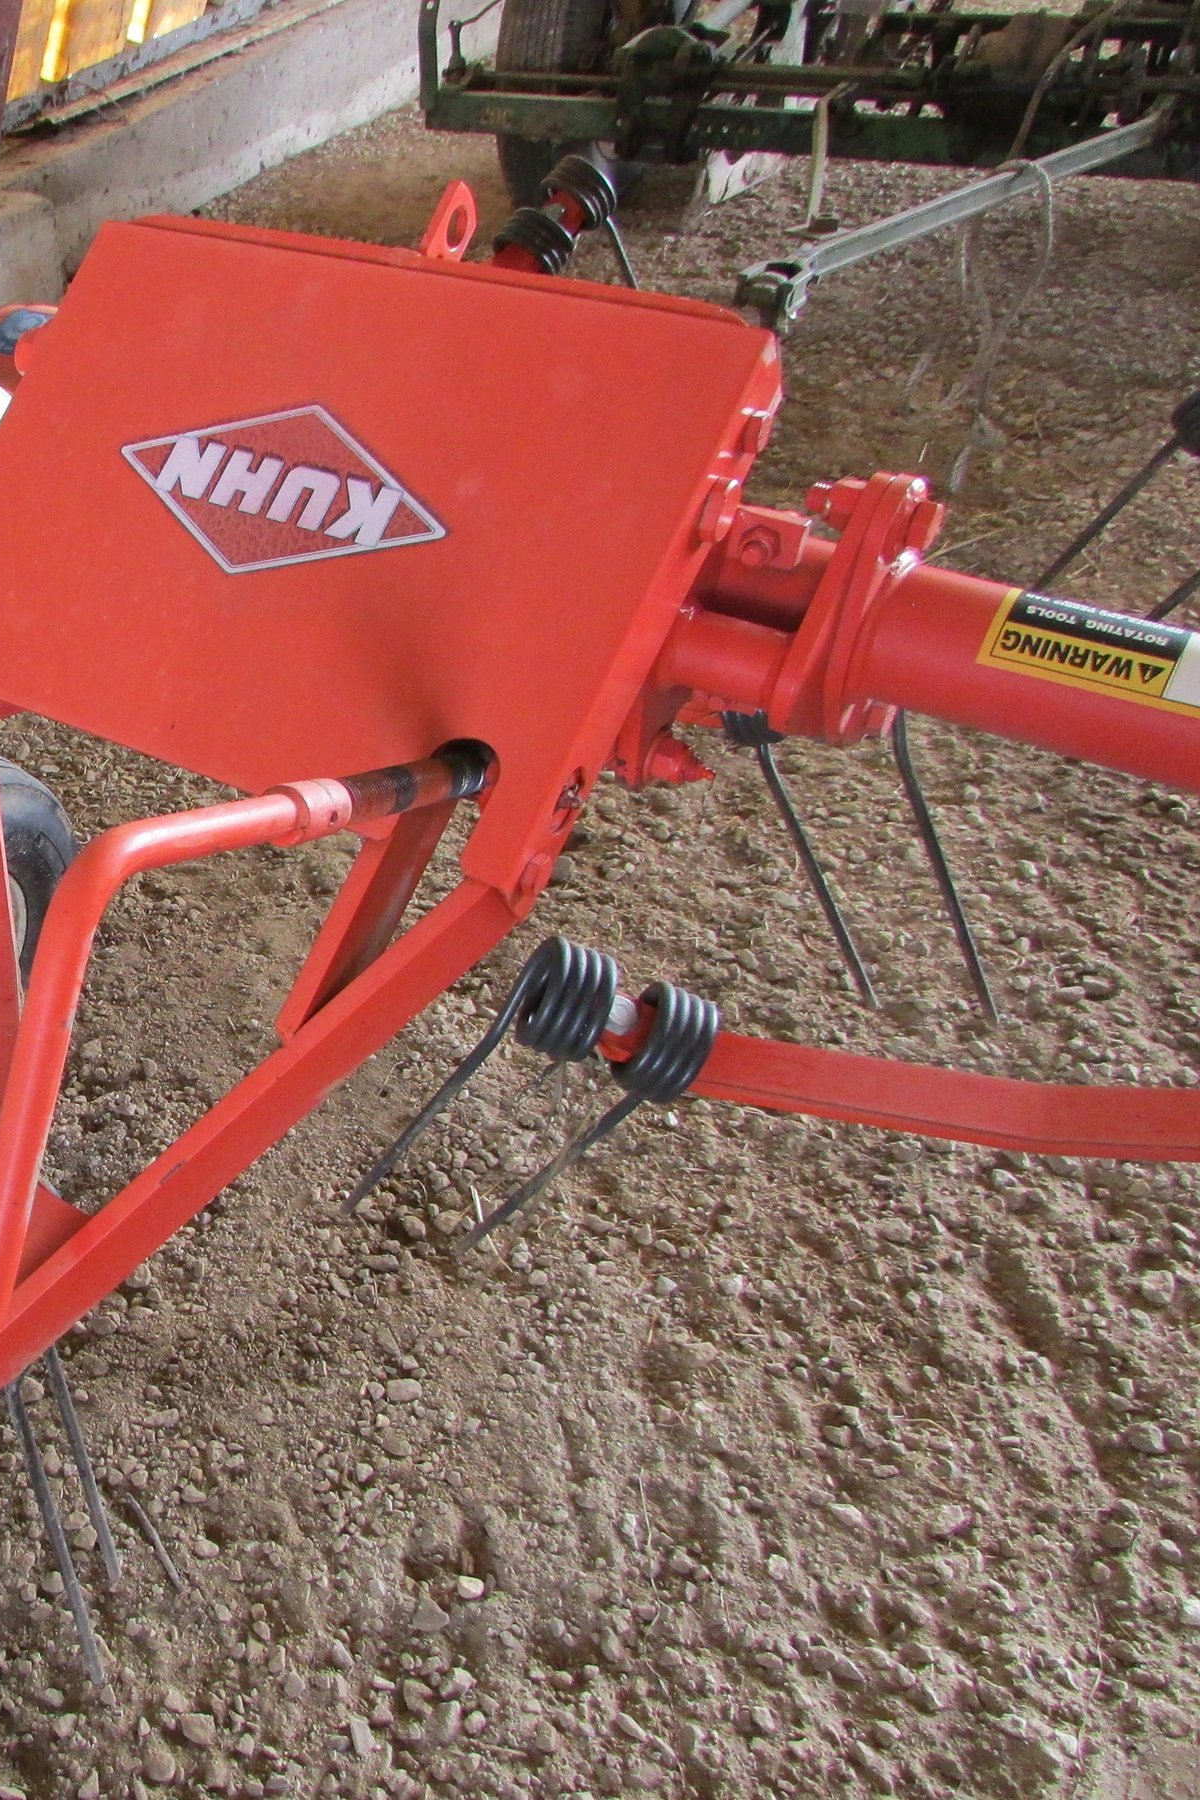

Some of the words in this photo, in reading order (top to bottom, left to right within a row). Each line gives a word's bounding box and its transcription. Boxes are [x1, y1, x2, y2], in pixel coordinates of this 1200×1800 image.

[154, 434, 404, 549] KUHN
[1025, 605, 1076, 626] TOOLS
[1085, 620, 1171, 647] ROTATING
[1000, 628, 1134, 681] WARNING
